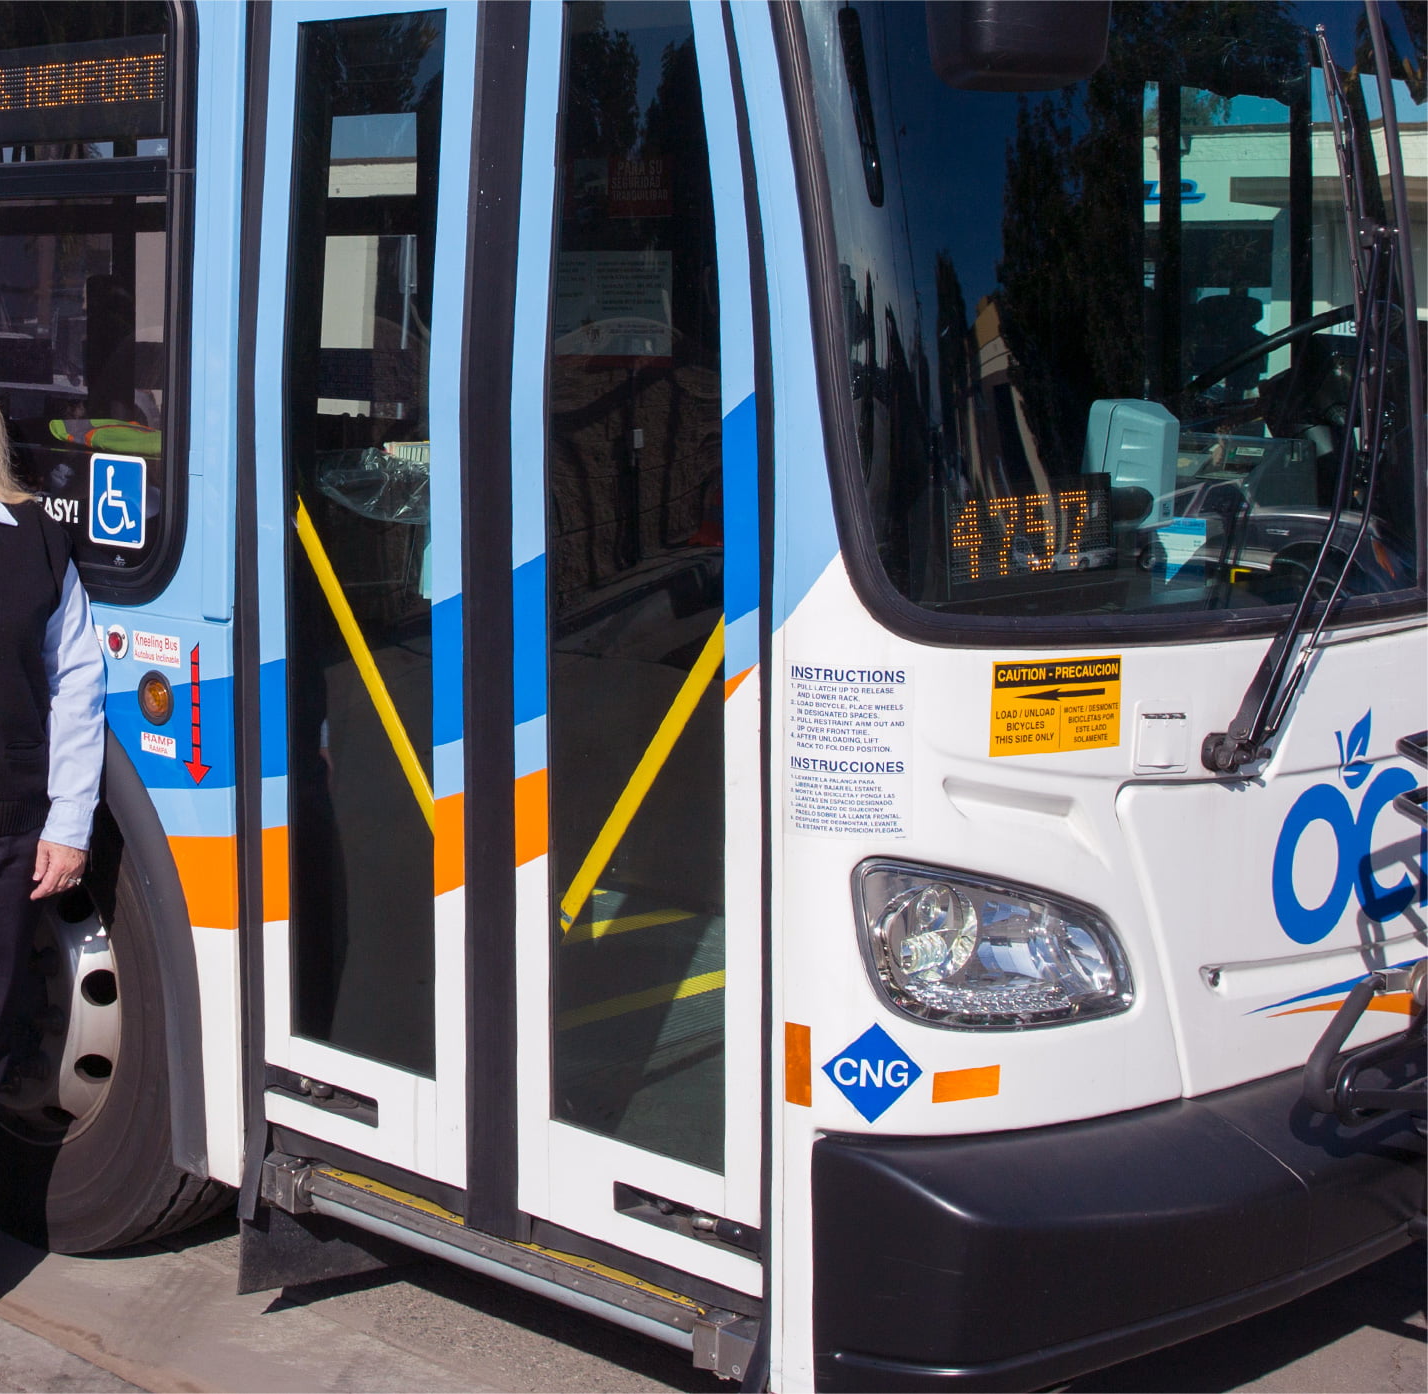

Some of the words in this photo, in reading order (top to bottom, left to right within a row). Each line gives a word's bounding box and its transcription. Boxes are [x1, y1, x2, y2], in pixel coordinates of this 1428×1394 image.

[25, 53, 165, 108] NEWPORT
[618, 160, 646, 175] PARA
[649, 159, 662, 175] SU
[612, 175, 662, 190] SEGURIDAD
[34, 496, 79, 524] ASY!
[952, 490, 1088, 578] 4757
[134, 631, 163, 652] Kneeling
[164, 637, 178, 651] Bus
[134, 649, 155, 661] Autobus
[155, 653, 180, 665] Inclinable
[790, 665, 906, 684] INSTRUCTIONS
[997, 667, 1047, 682] CAUTION
[1055, 662, 1119, 680] PRECAUCION
[797, 691, 811, 699] AND
[804, 709, 848, 718] DESIGNATED
[996, 710, 1020, 720] LOAD
[1024, 707, 1056, 718] UNLOAD
[1063, 705, 1085, 713] MONTE
[1088, 702, 1119, 712] DESMONTE
[813, 718, 853, 726] RESTRAINT
[1067, 714, 1102, 724] BICICLETAS
[1102, 713, 1115, 721] POR
[826, 727, 851, 735] FRONT
[1006, 721, 1045, 732] BICYCLES
[1075, 725, 1090, 733] ESTE
[1091, 723, 1107, 732] LADO
[143, 732, 174, 747] RAMP
[797, 732, 817, 740] AFTER
[995, 735, 1013, 745] THIS
[1014, 734, 1033, 743] SIDE
[1035, 732, 1055, 743] ONLY
[1073, 733, 1109, 744] SOLAMENTE
[149, 744, 169, 754] RAMPA
[797, 741, 814, 749] RACK
[790, 756, 905, 773] INSTRUCCIONES
[833, 1056, 910, 1090] CNG
